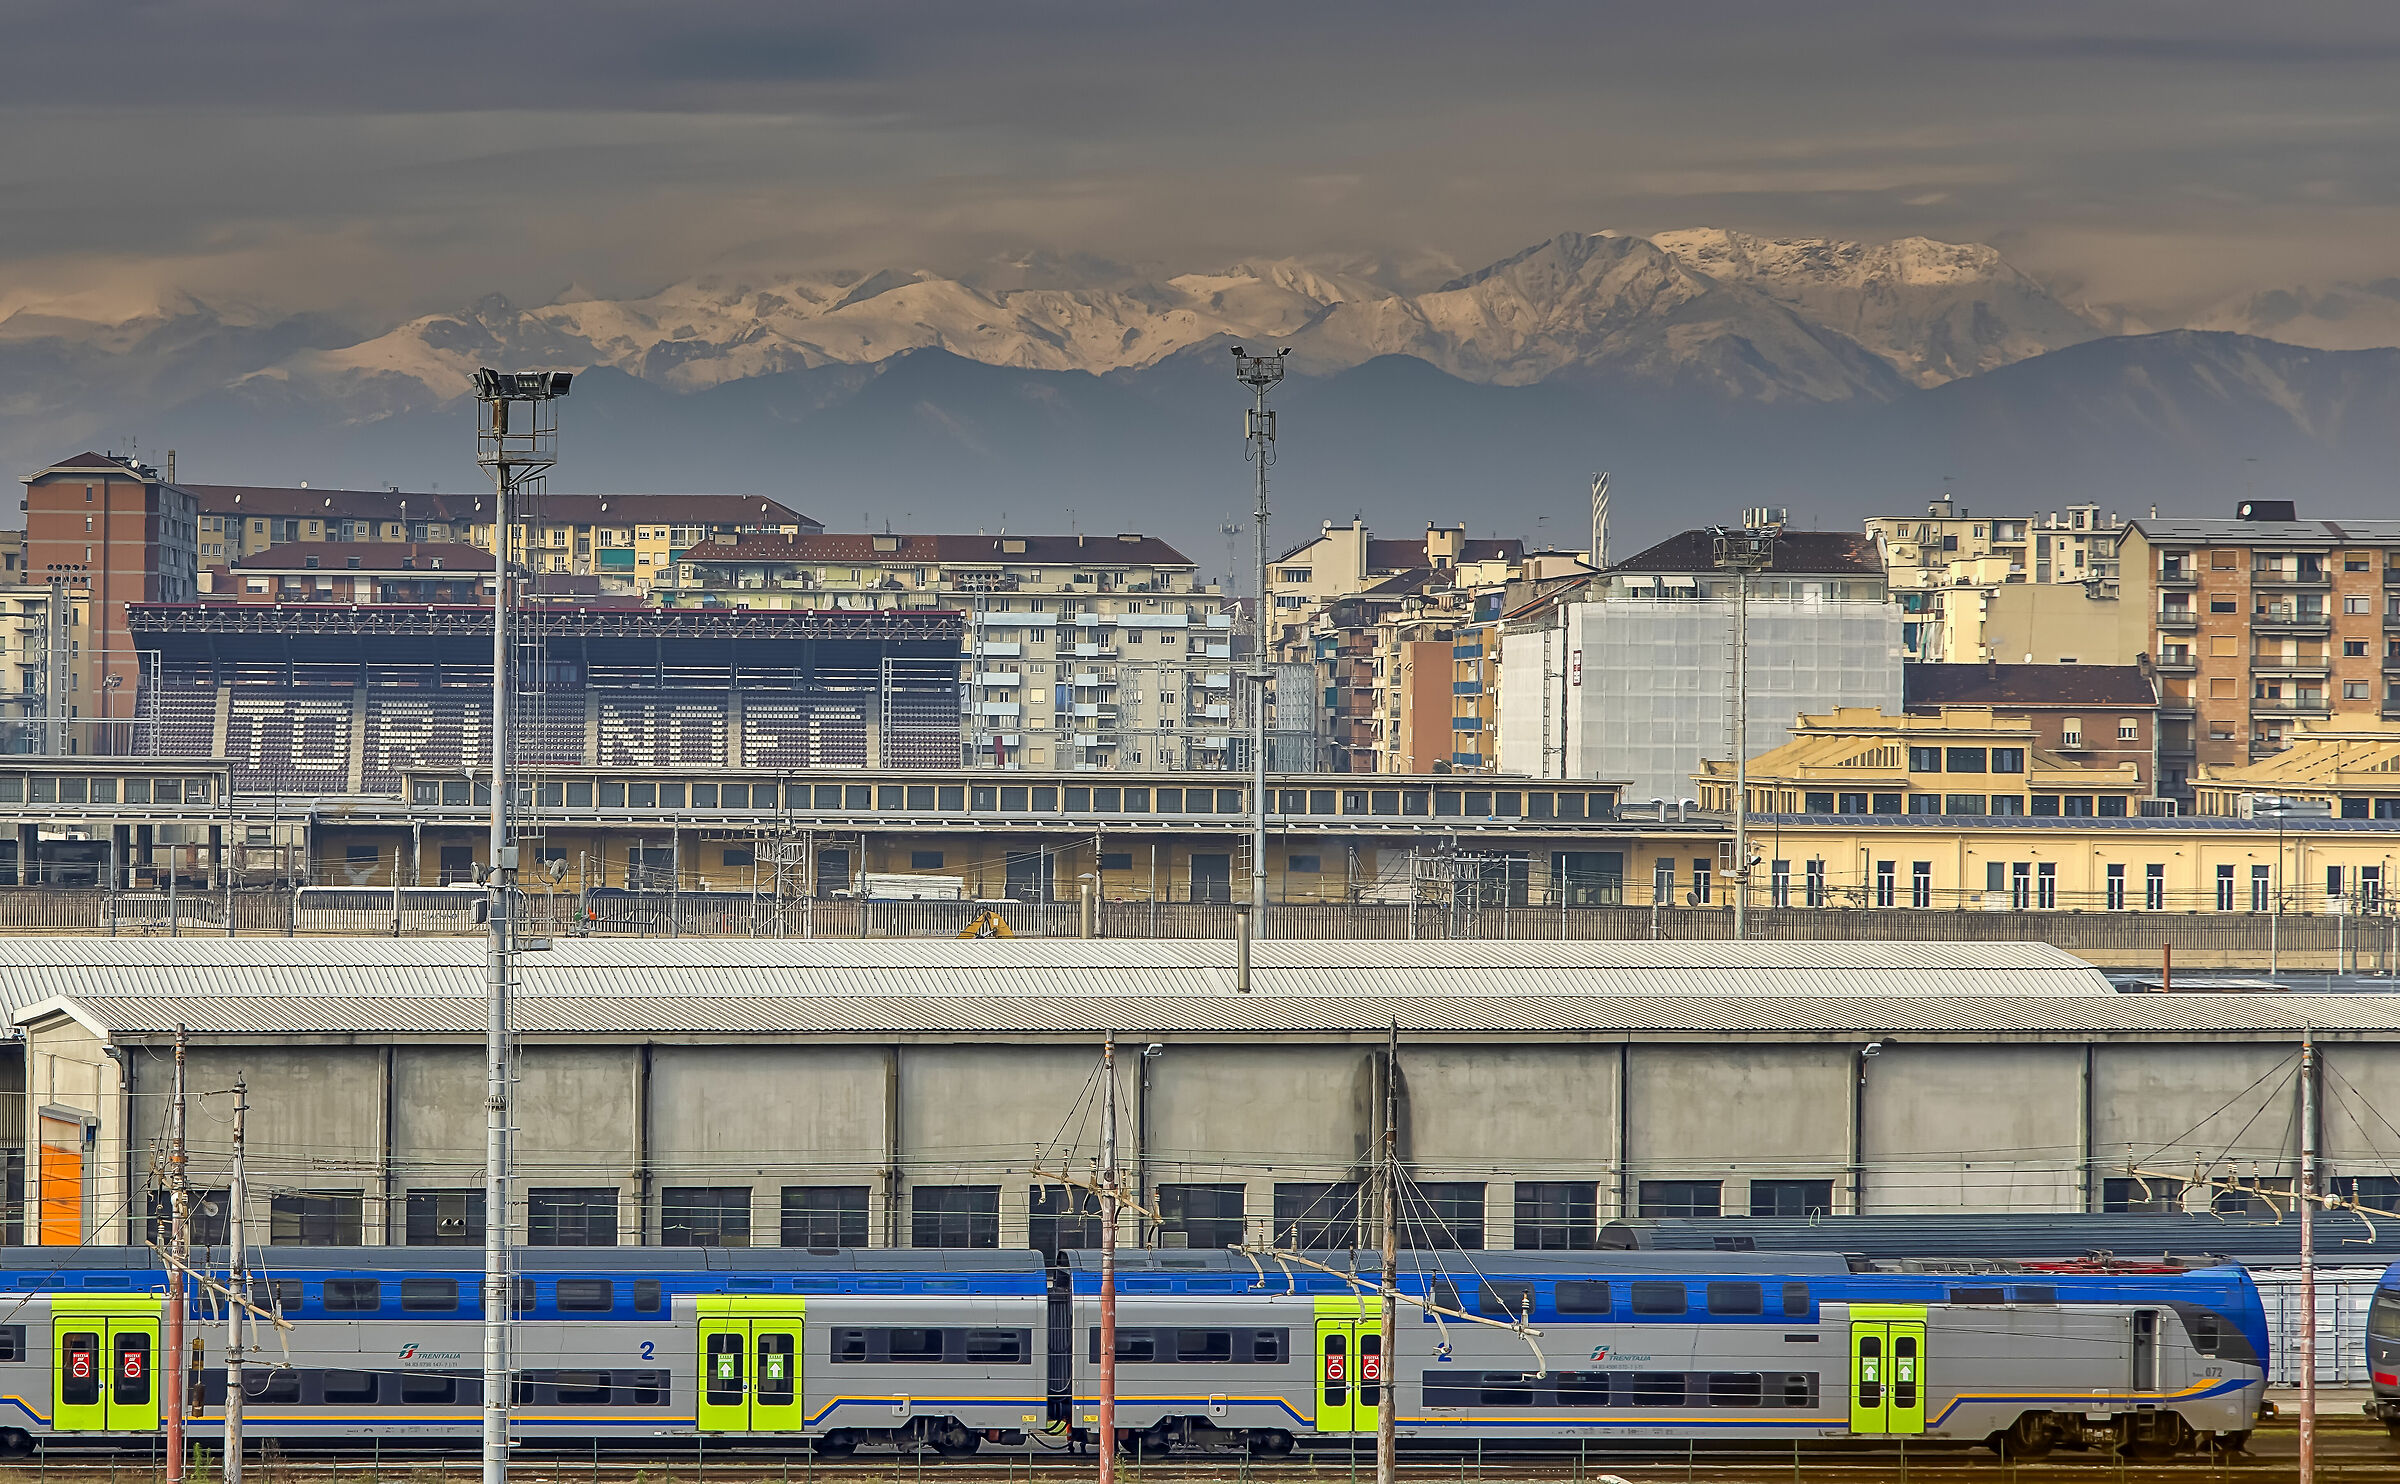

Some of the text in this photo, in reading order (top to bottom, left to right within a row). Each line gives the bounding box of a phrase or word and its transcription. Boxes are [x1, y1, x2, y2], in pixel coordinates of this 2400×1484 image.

[233, 700, 722, 770] TORINO
[640, 1340, 655, 1360] 2
[1437, 1341, 1452, 1362] 2
[2205, 1367, 2223, 1377] 072
